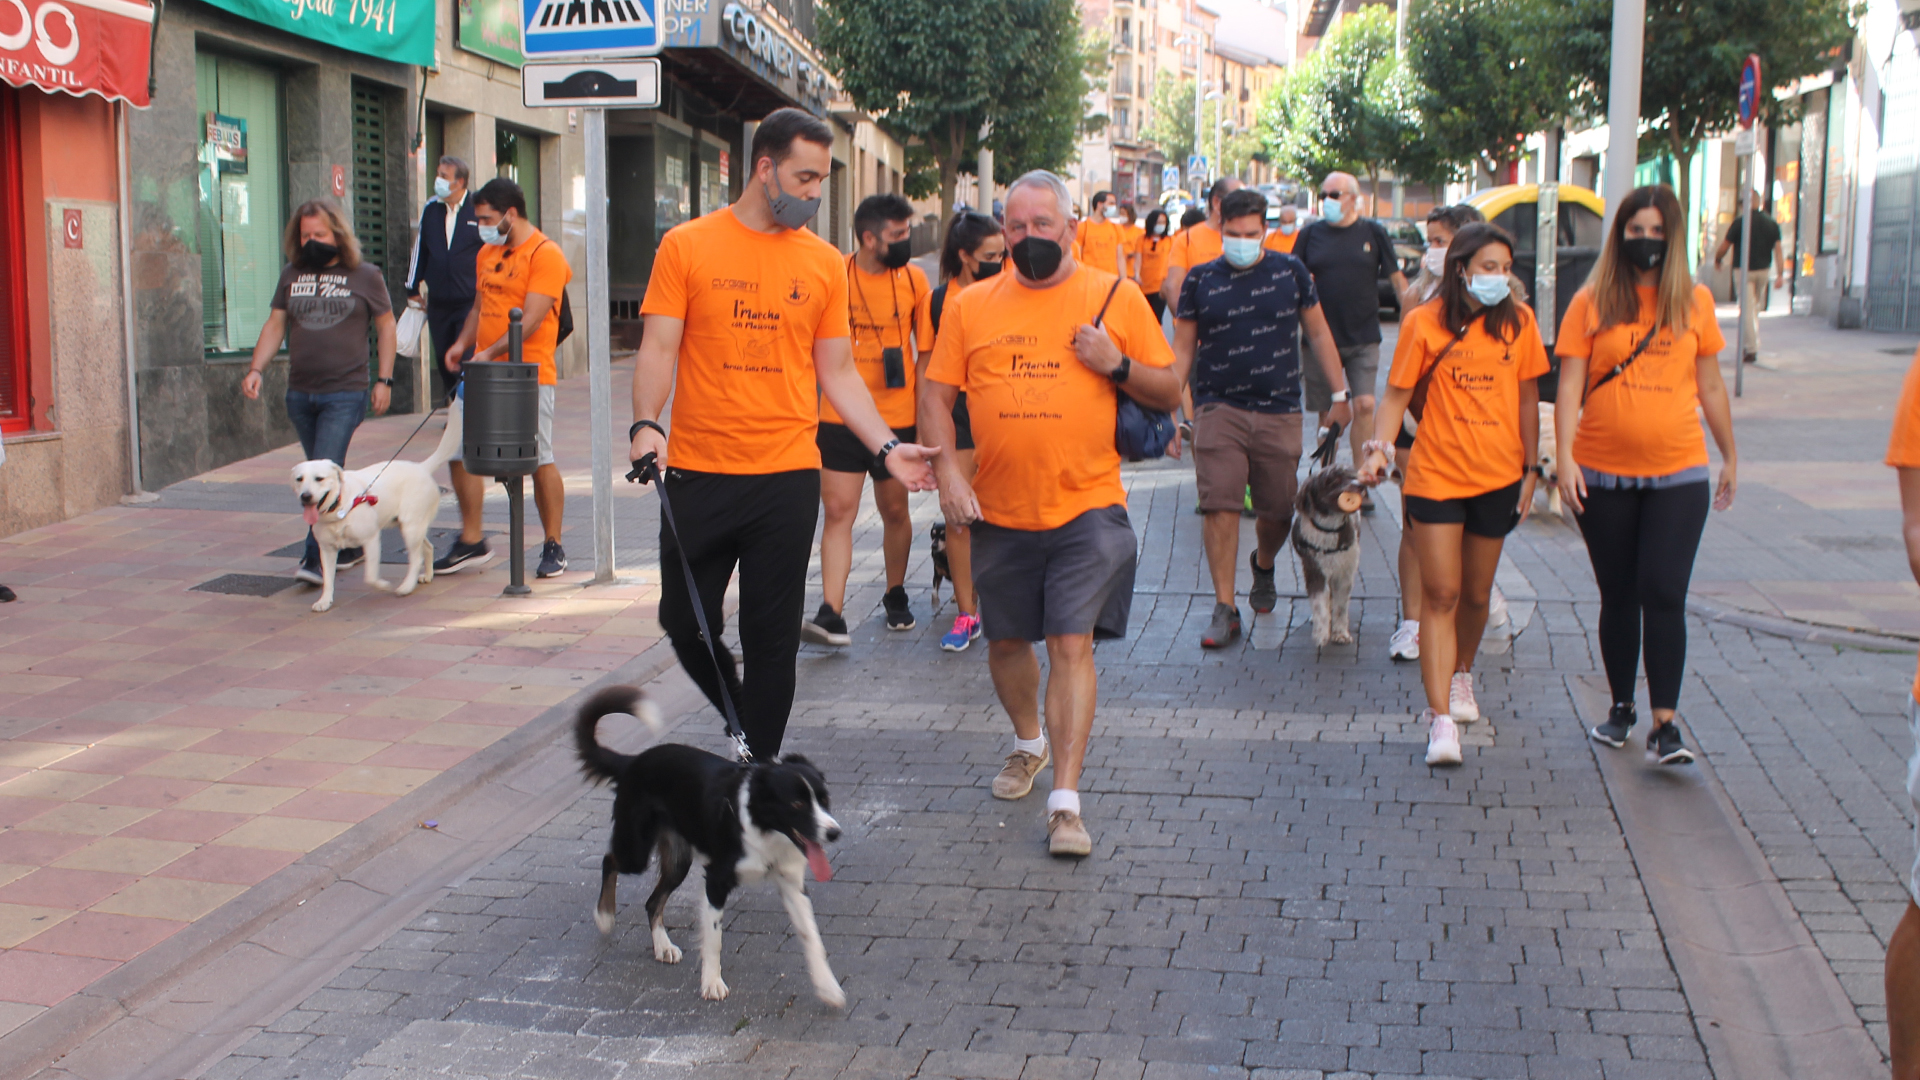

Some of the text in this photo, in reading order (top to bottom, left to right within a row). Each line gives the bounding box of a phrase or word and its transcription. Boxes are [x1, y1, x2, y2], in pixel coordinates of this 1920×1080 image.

[723, 2, 793, 79] CORNER
[298, 273, 347, 285] LOOK INSIDE
[319, 282, 351, 298] New
[740, 309, 780, 320] Marcha
